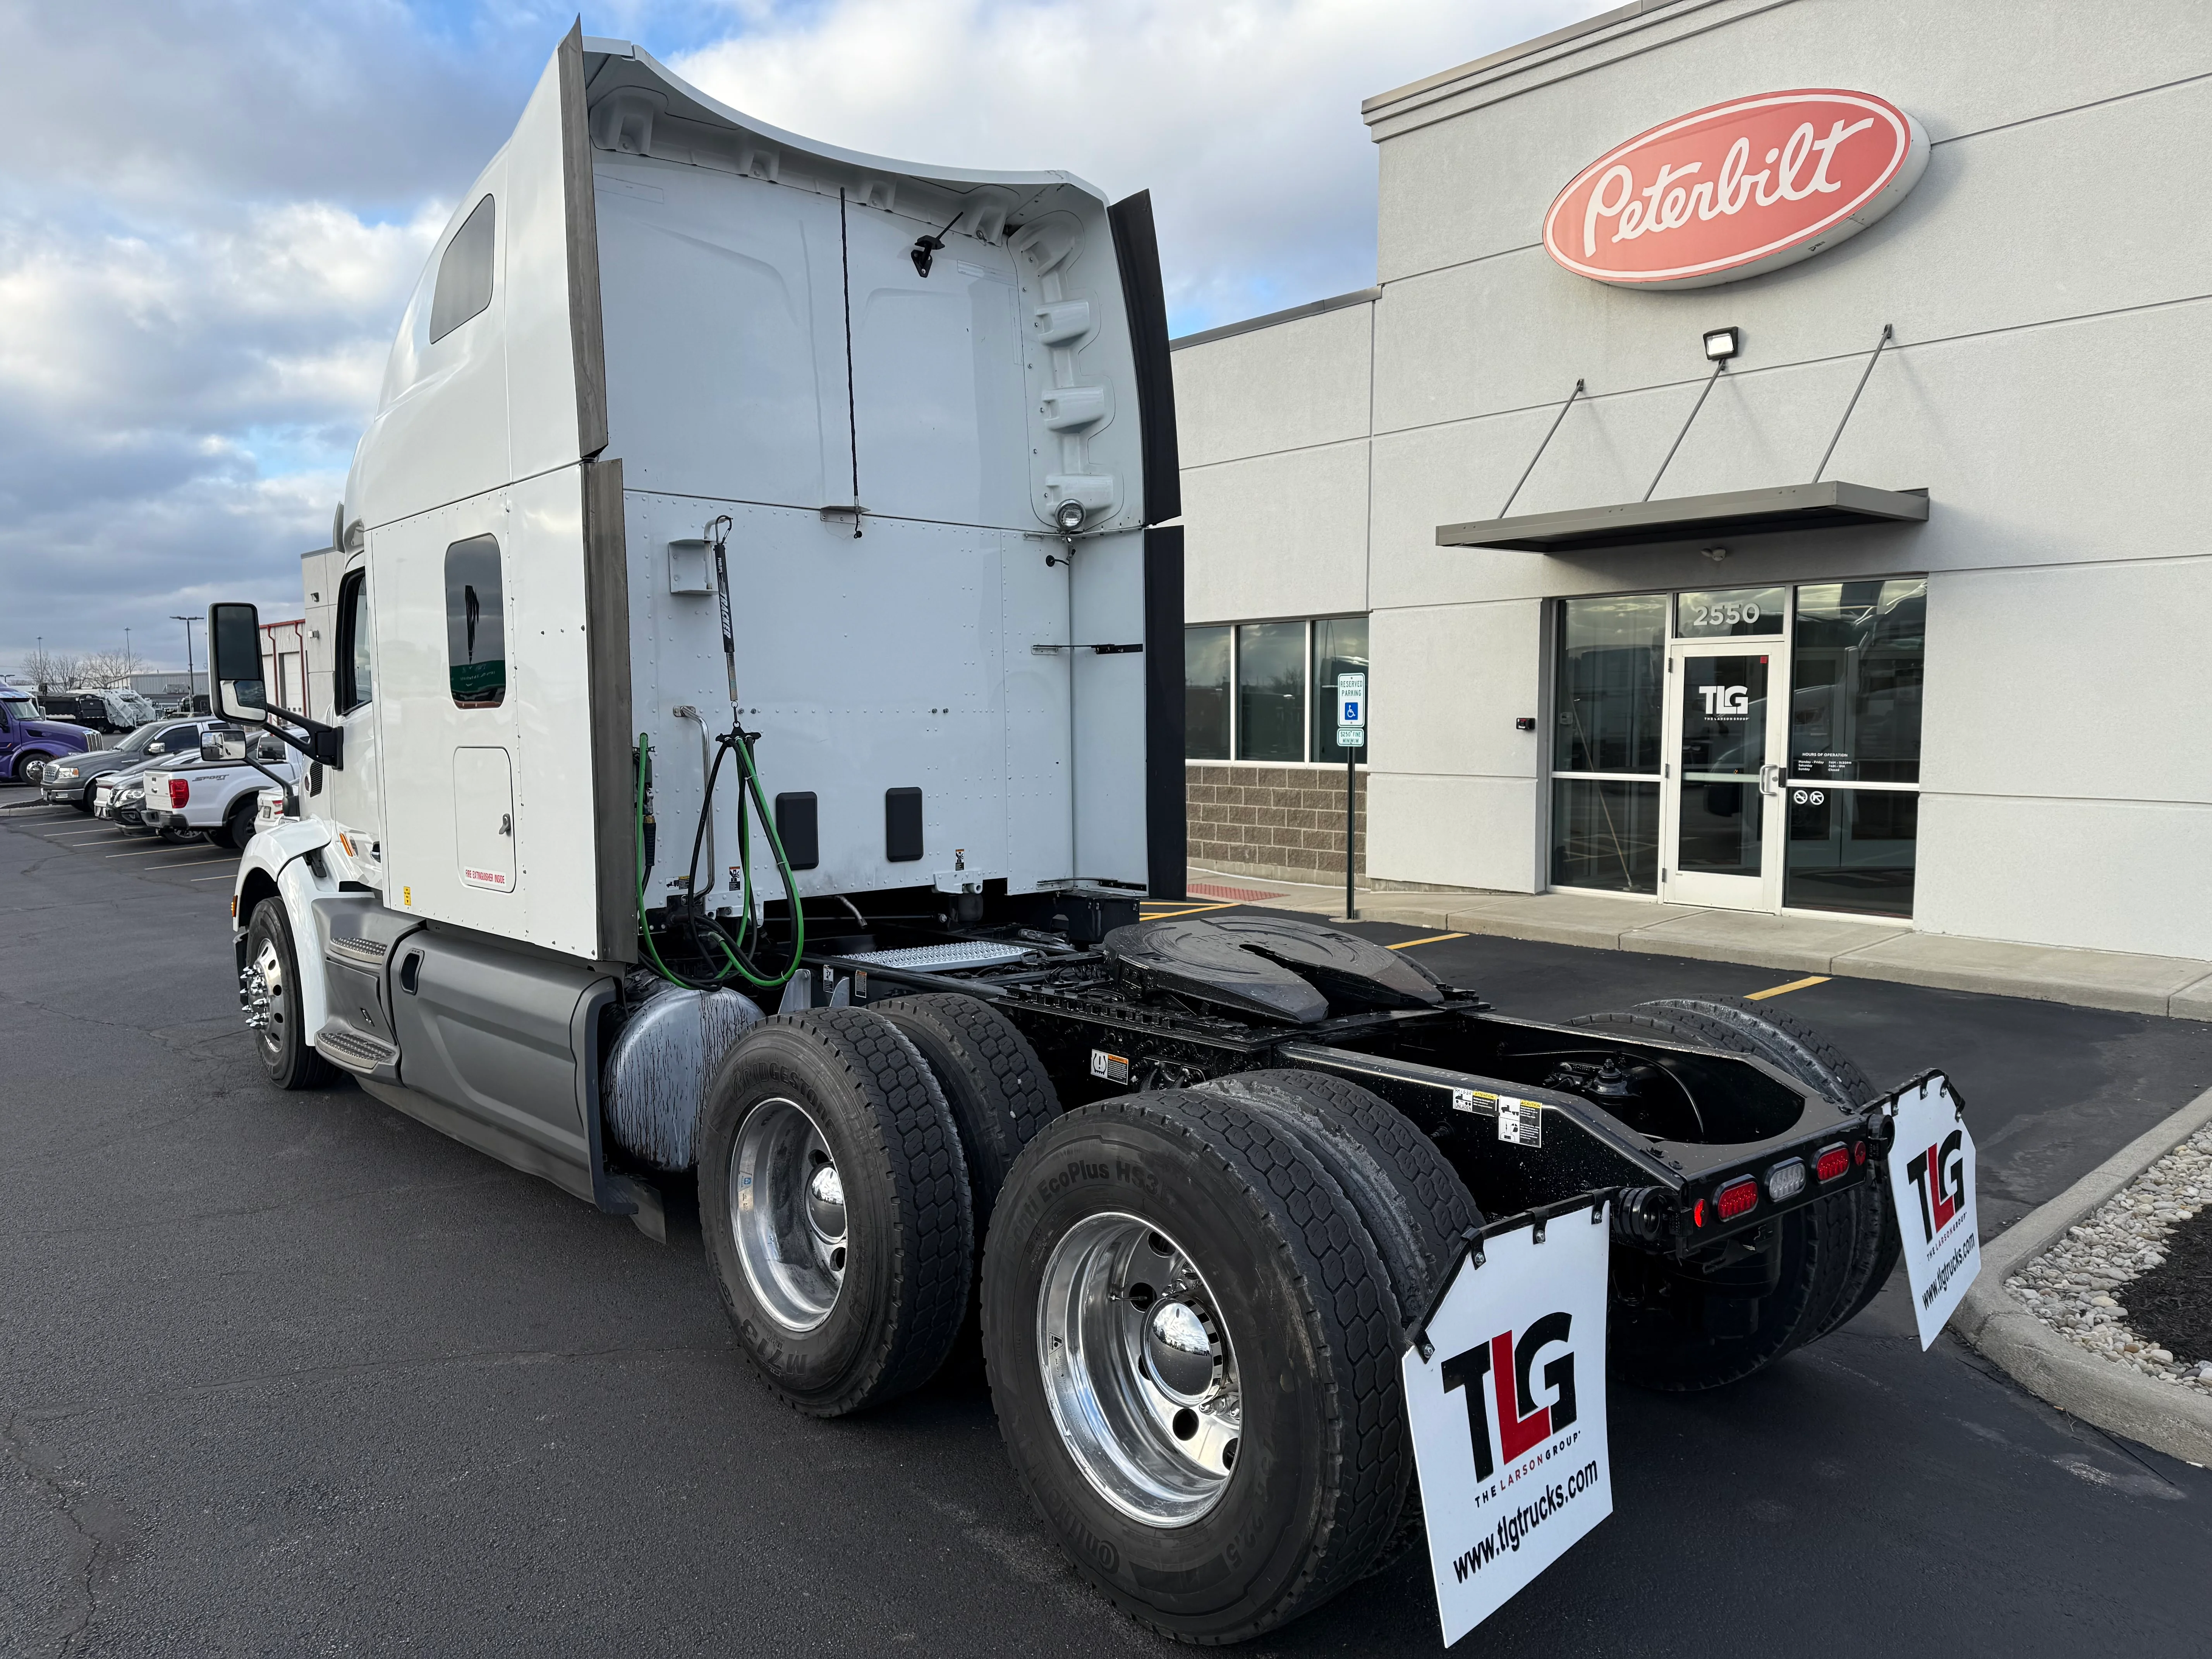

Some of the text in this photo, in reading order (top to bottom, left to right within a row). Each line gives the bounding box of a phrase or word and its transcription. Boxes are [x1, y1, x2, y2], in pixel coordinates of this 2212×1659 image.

[1583, 117, 1874, 258] Peterbilt
[720, 592, 731, 639] TRACKER
[1693, 603, 1760, 626] 2550
[1699, 685, 1748, 714] TLG
[495, 874, 505, 884] INSIDE
[1037, 1160, 1110, 1203] EcoPlus
[1907, 1130, 1965, 1244] TLG
[1922, 1232, 1975, 1311] www.tlgtrucks.com
[1927, 1247, 1936, 1262] THE
[1441, 1312, 1577, 1484] TLG
[1475, 1485, 1497, 1508] THE
[1453, 1460, 1598, 1584] www.tlgtrucks.com
